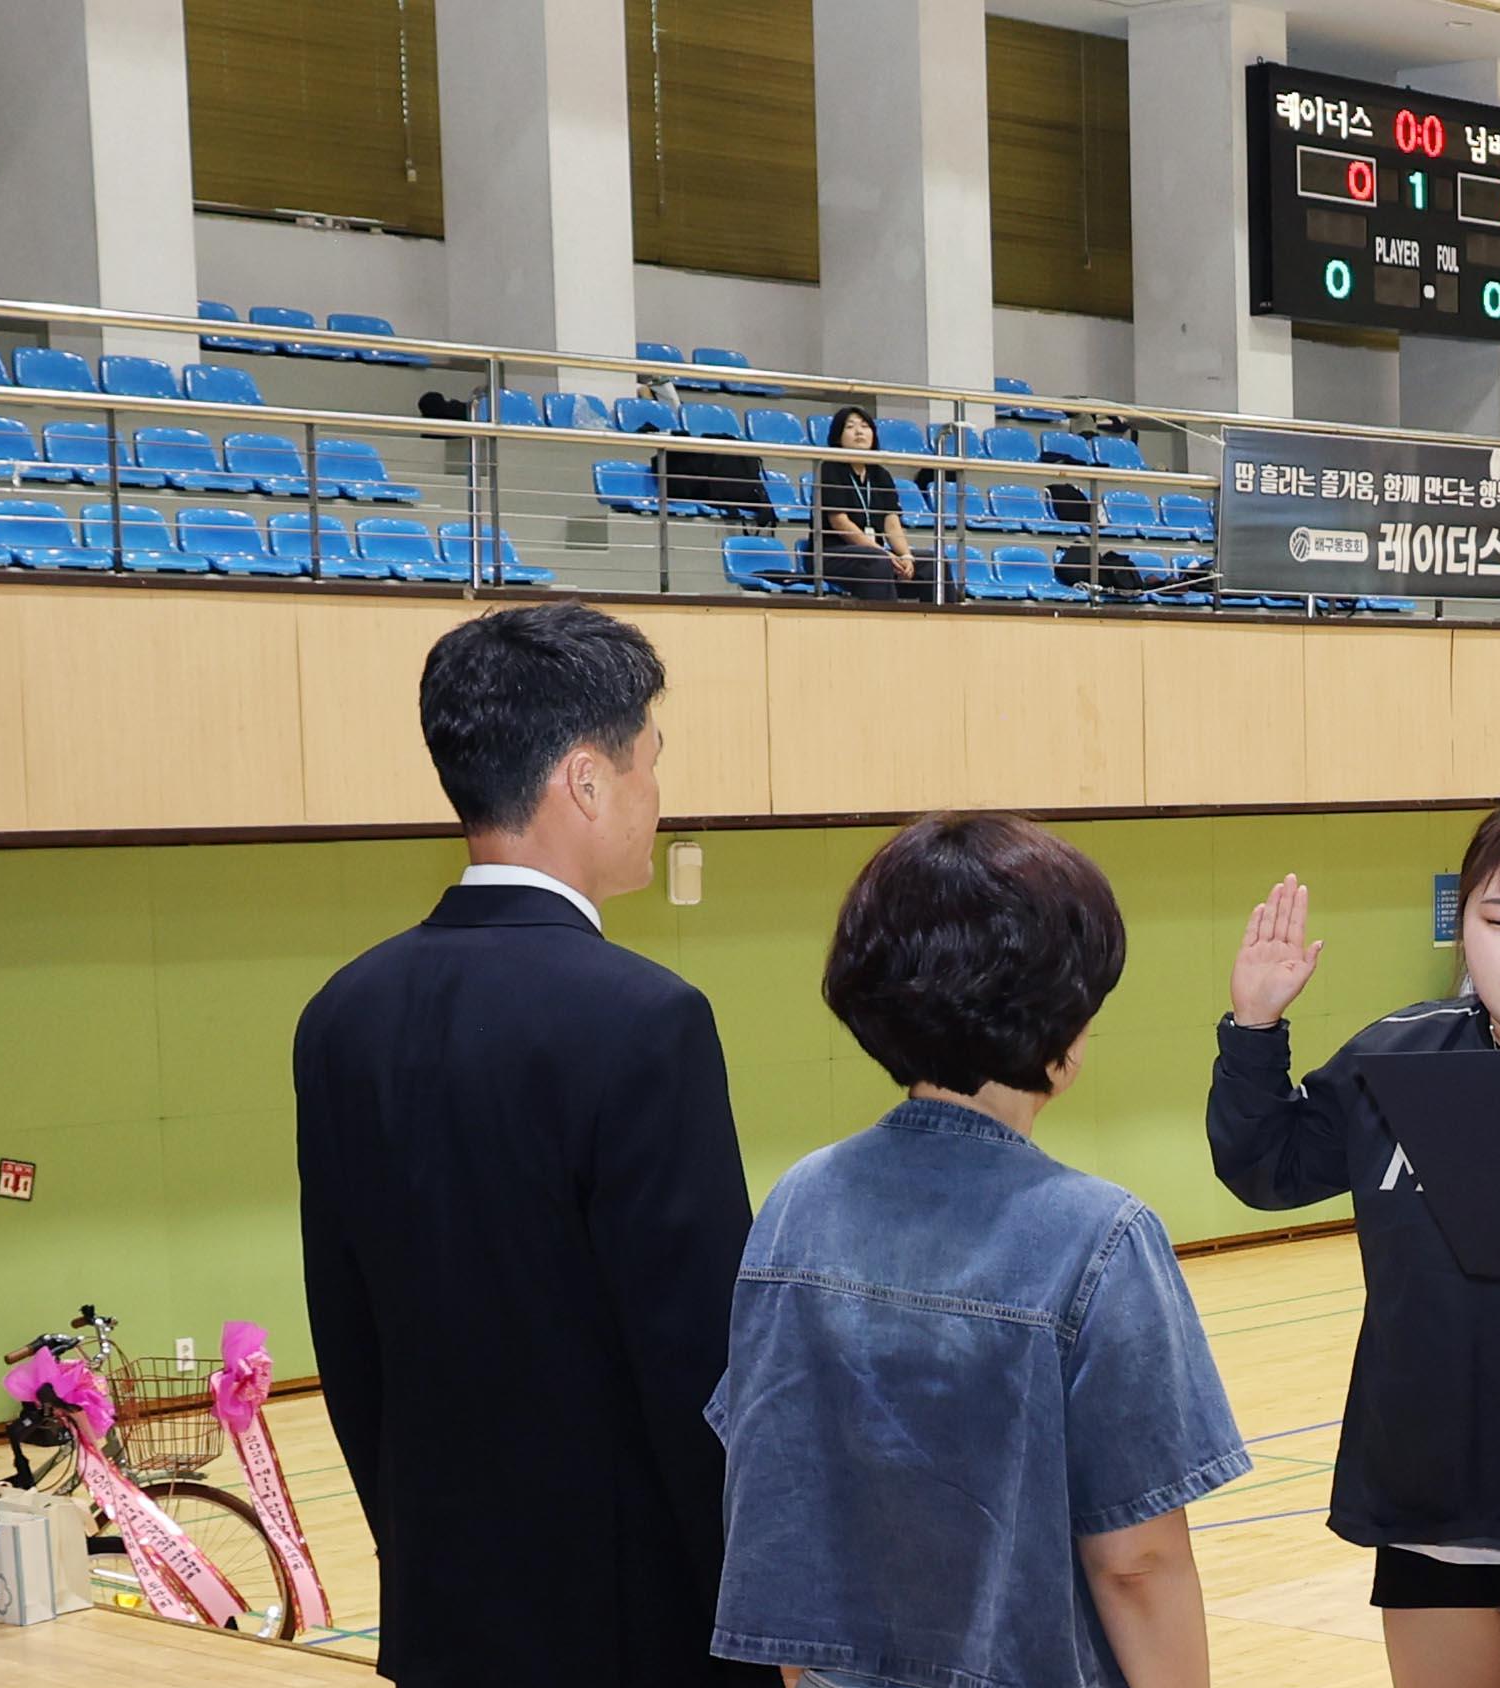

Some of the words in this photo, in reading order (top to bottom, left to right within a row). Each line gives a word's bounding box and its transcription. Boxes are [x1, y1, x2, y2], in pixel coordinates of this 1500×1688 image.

[1276, 92, 1373, 139] 레이더스
[1347, 161, 1373, 200] 0
[1408, 171, 1425, 210] 1
[1375, 236, 1420, 267] PLAYER
[1436, 244, 1460, 273] FOUL
[1326, 259, 1351, 299] 0
[1235, 461, 1255, 493] 땀
[1260, 463, 1316, 497] 흘리는
[1320, 468, 1380, 506] 즐거움,
[1383, 473, 1420, 501] 함께
[1424, 475, 1475, 506] 만드는
[1313, 537, 1364, 554] 배구동호회
